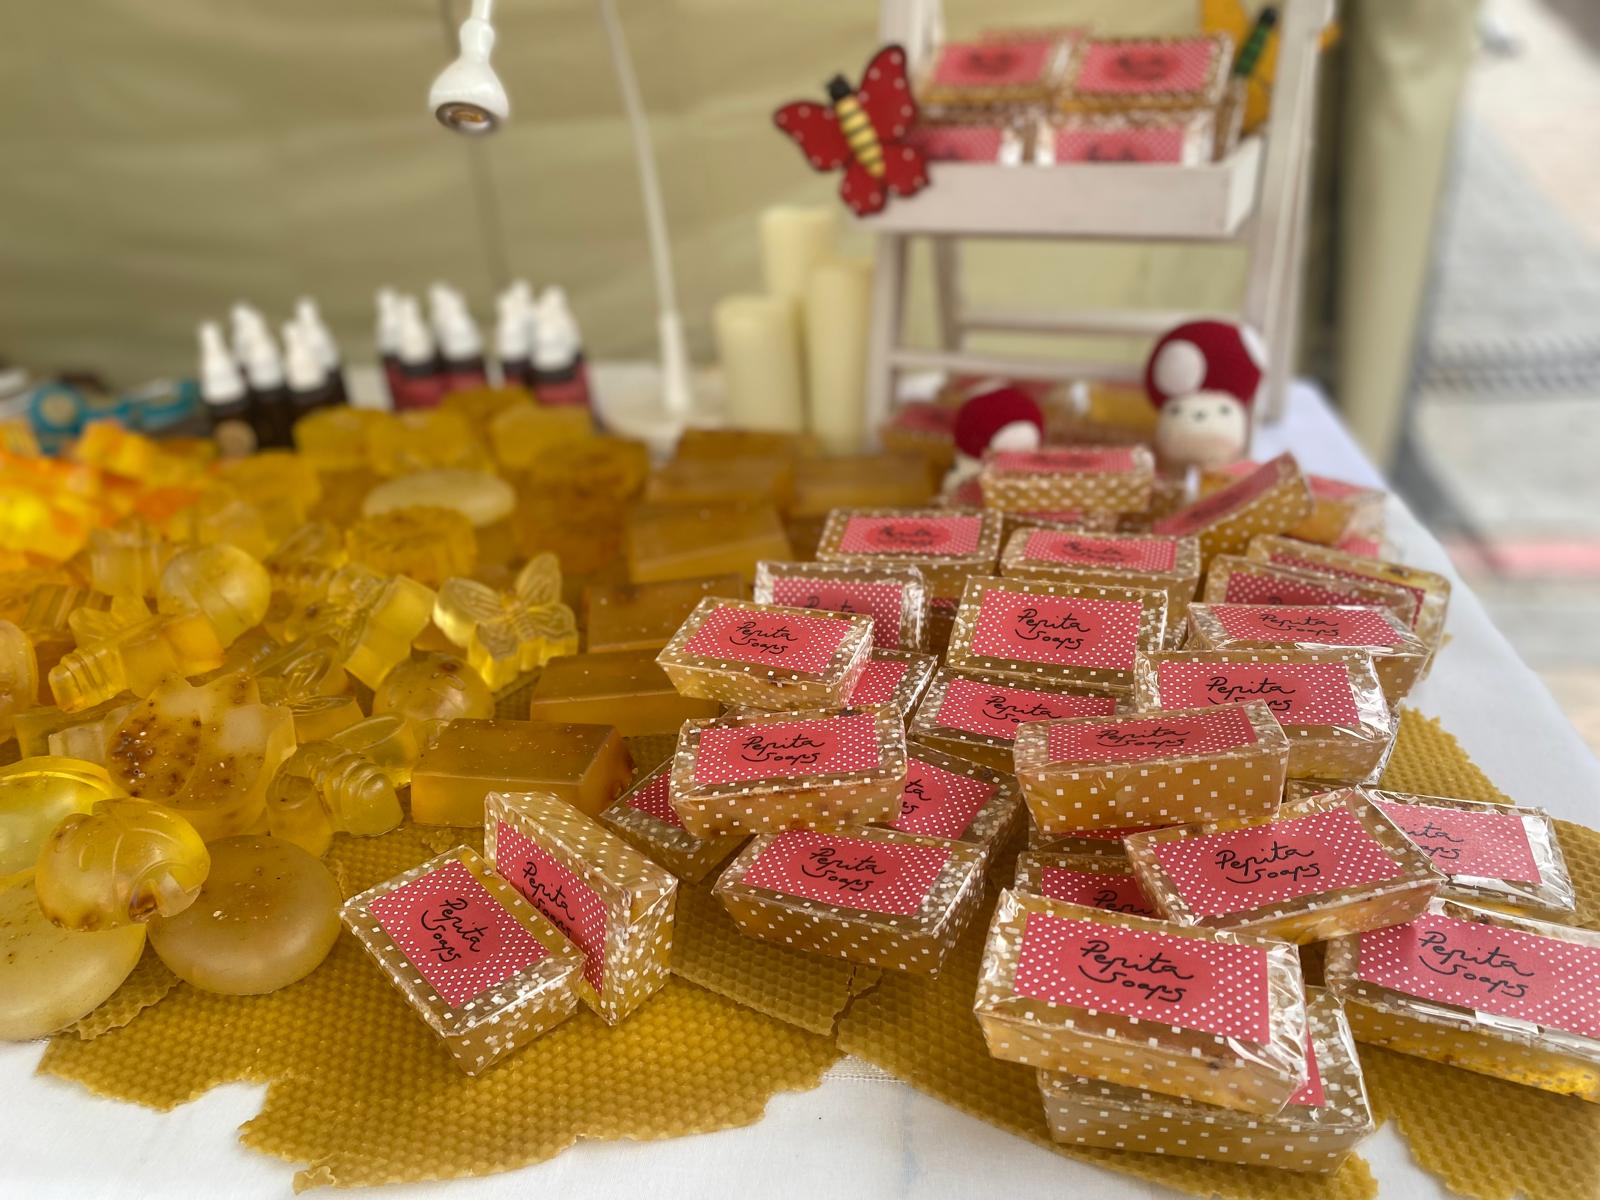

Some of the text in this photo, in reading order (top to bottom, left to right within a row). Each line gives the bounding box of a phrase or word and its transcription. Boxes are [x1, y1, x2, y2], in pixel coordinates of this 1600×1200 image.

[735, 621, 798, 641] Pepita
[1017, 608, 1091, 633] Pepita
[1259, 613, 1339, 628] Pepita
[1263, 624, 1339, 636] Soaps
[729, 636, 789, 654] Soaps
[1014, 629, 1084, 650] Soaps
[1206, 676, 1296, 700] Pepita
[985, 695, 1062, 719] Pepita
[742, 733, 825, 756] Pepita
[1096, 726, 1191, 743] Pepita
[1097, 738, 1186, 749] Soaps
[741, 752, 821, 766] Soaps
[809, 847, 887, 875] Pepita
[1215, 841, 1315, 876] Pepita
[801, 864, 874, 891] Soaps
[1225, 862, 1320, 883] Soaps
[523, 861, 575, 921] Pepita
[421, 910, 461, 963] Soaps
[432, 897, 488, 952] Pepita
[1080, 940, 1194, 980] Pepita
[1418, 931, 1535, 977] Pepita
[1078, 965, 1187, 1003] Soaps
[1419, 955, 1529, 998] Soaps
